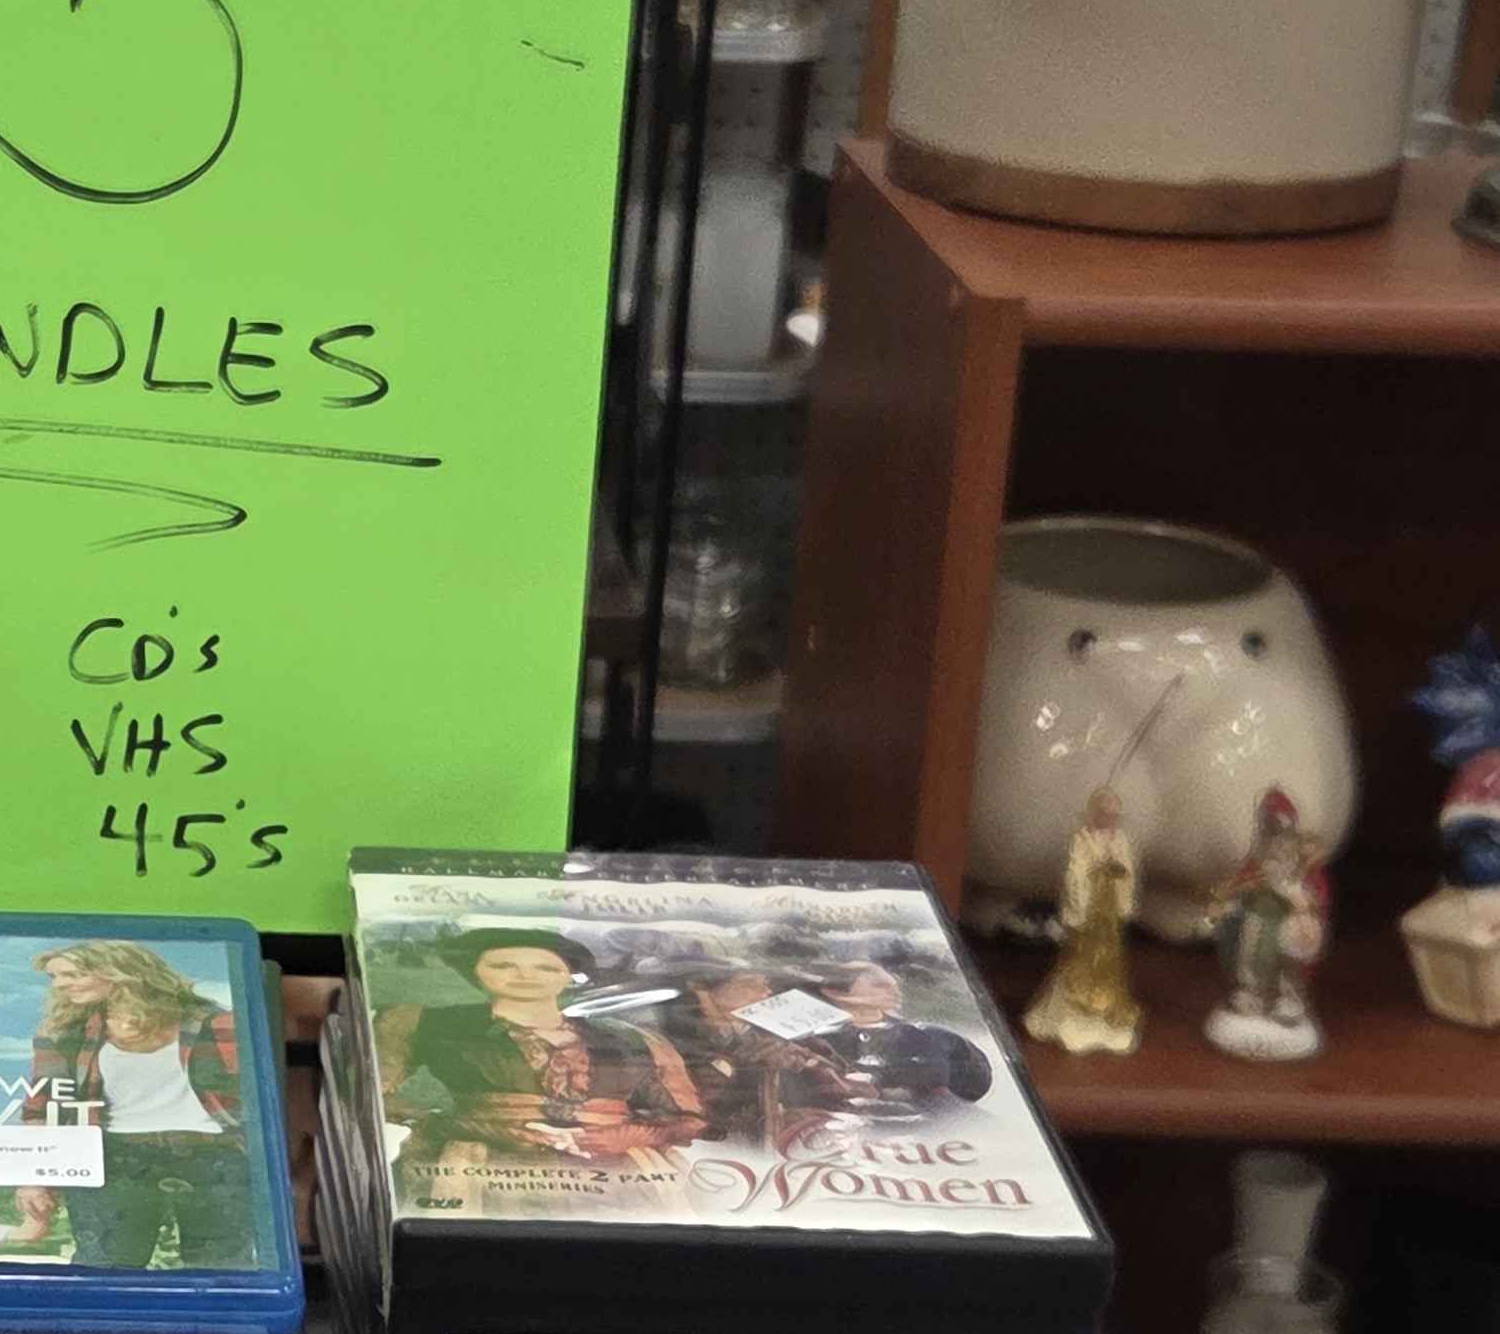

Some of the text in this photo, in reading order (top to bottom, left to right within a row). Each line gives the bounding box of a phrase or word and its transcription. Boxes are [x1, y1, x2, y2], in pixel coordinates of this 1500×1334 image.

[70, 703, 229, 777] VHS
[100, 798, 290, 878] 45's
[45, 1101, 105, 1127] IT
[34, 1167, 92, 1178] $5.00
[462, 1166, 581, 1179] COMPLETE
[589, 1169, 610, 1182] 2
[618, 1172, 679, 1184] PART
[690, 1158, 1034, 1211] Women
[487, 1180, 605, 1195] MINISERIES
